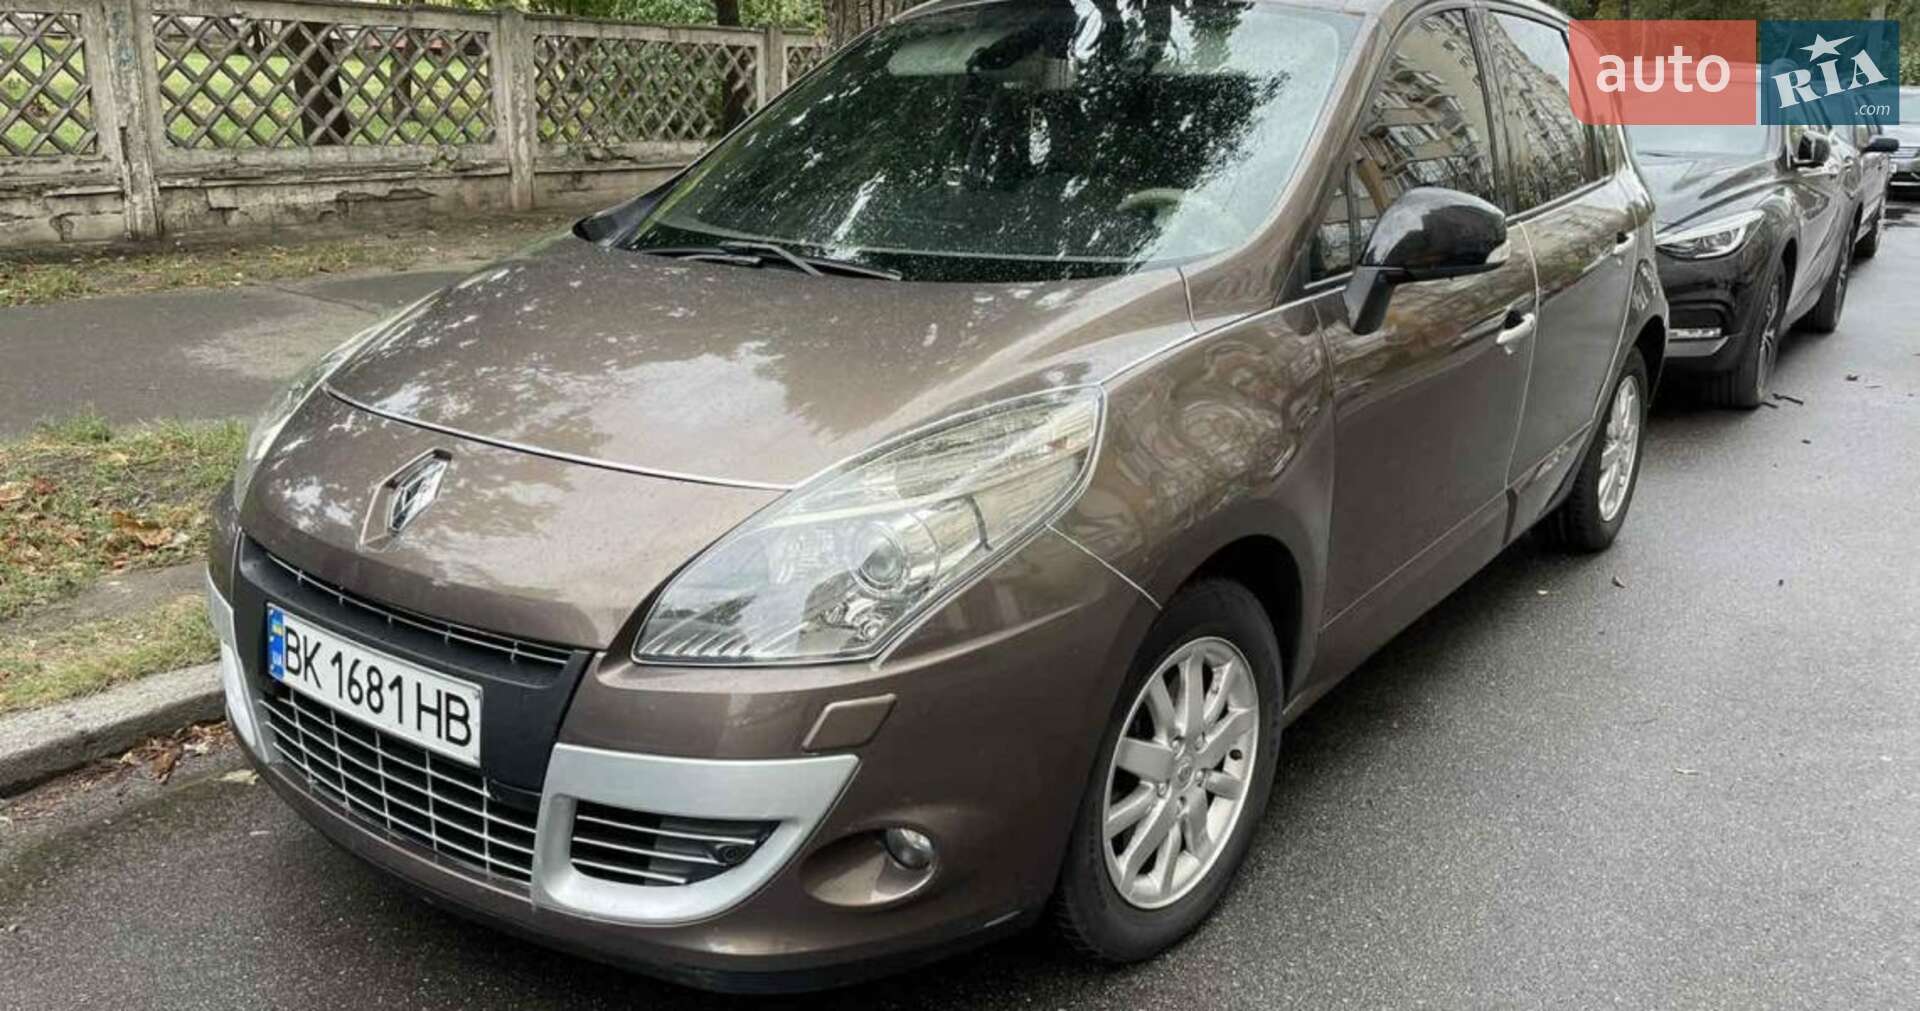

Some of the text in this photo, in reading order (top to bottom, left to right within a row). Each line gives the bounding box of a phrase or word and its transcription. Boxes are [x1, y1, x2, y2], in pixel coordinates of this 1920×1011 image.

[284, 626, 471, 747] BK 1681 HB
